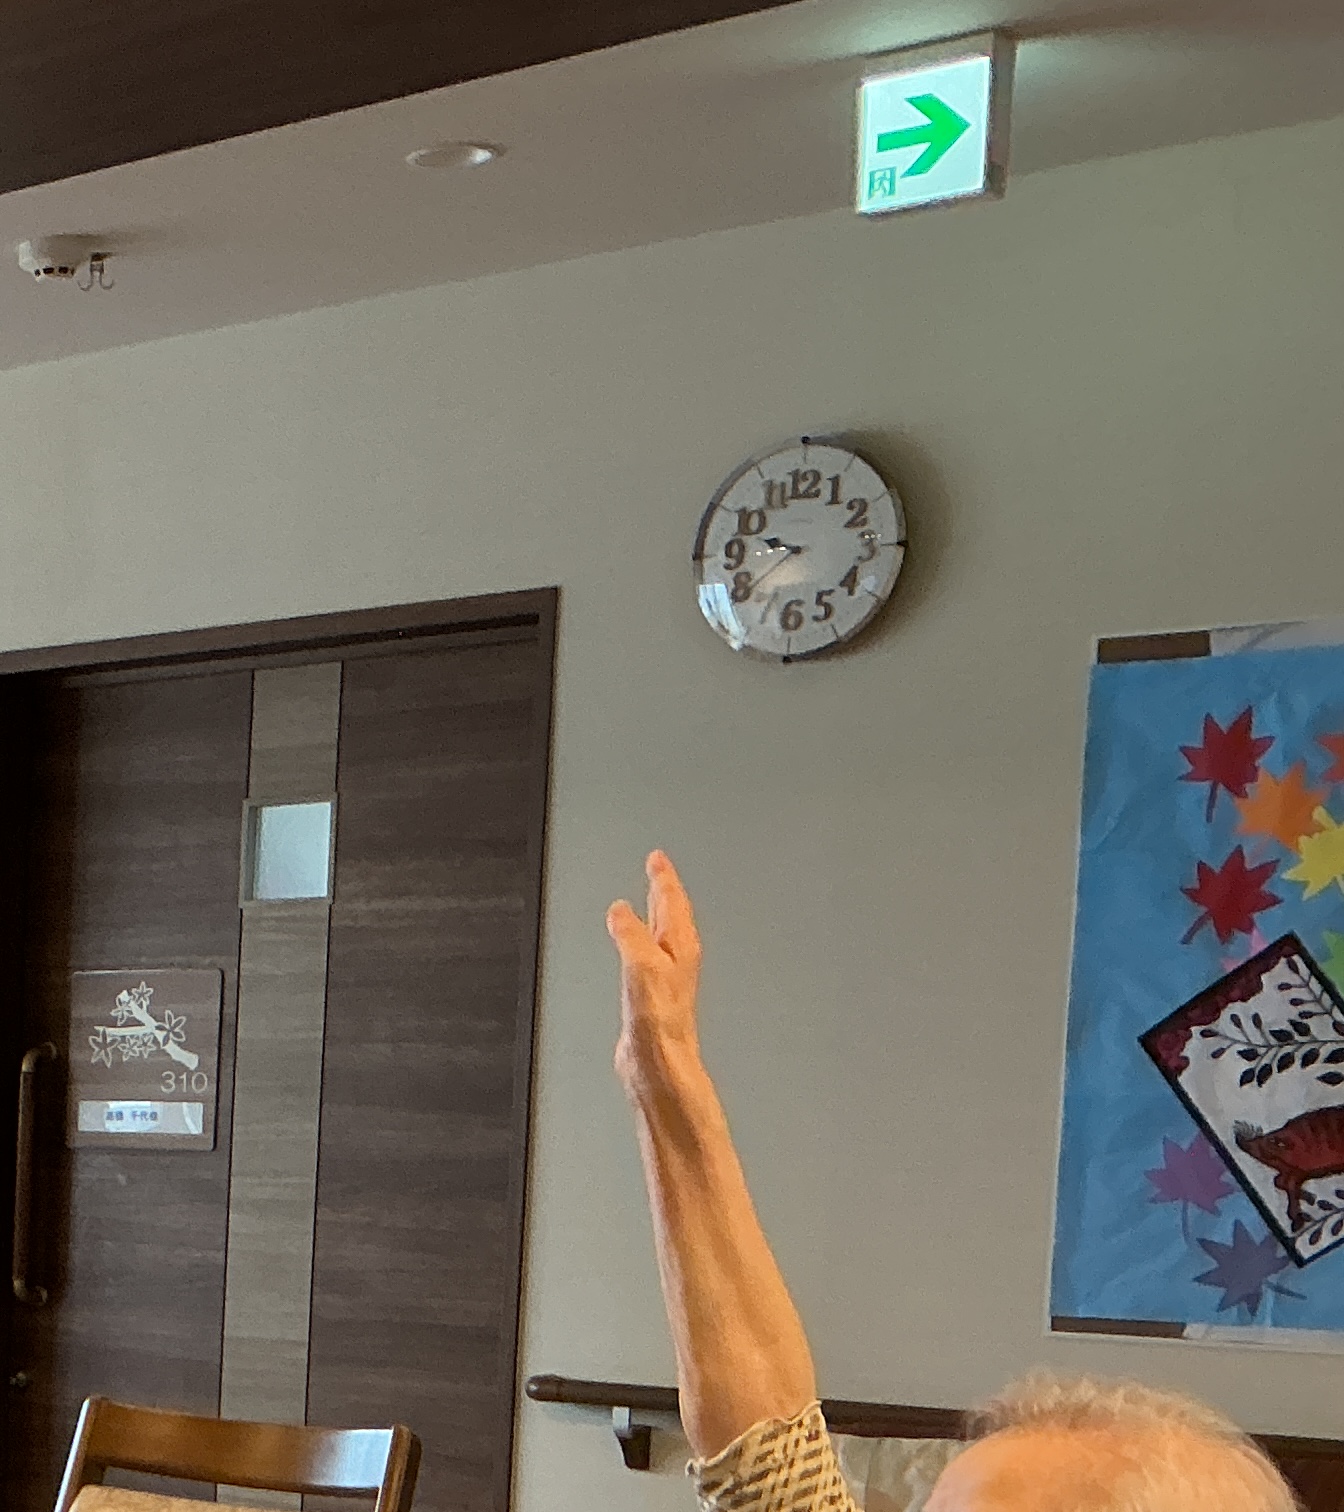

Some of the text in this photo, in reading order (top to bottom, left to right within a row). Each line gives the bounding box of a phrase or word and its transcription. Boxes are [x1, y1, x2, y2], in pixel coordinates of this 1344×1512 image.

[788, 468, 821, 500] 12
[825, 474, 842, 505] 1
[734, 507, 767, 536] 10
[844, 498, 868, 528] 2
[723, 538, 745, 570] 9
[731, 571, 752, 603] 8
[840, 565, 859, 596] 4
[780, 600, 805, 631] 6
[812, 589, 835, 622] 5
[160, 1070, 209, 1094] 310
